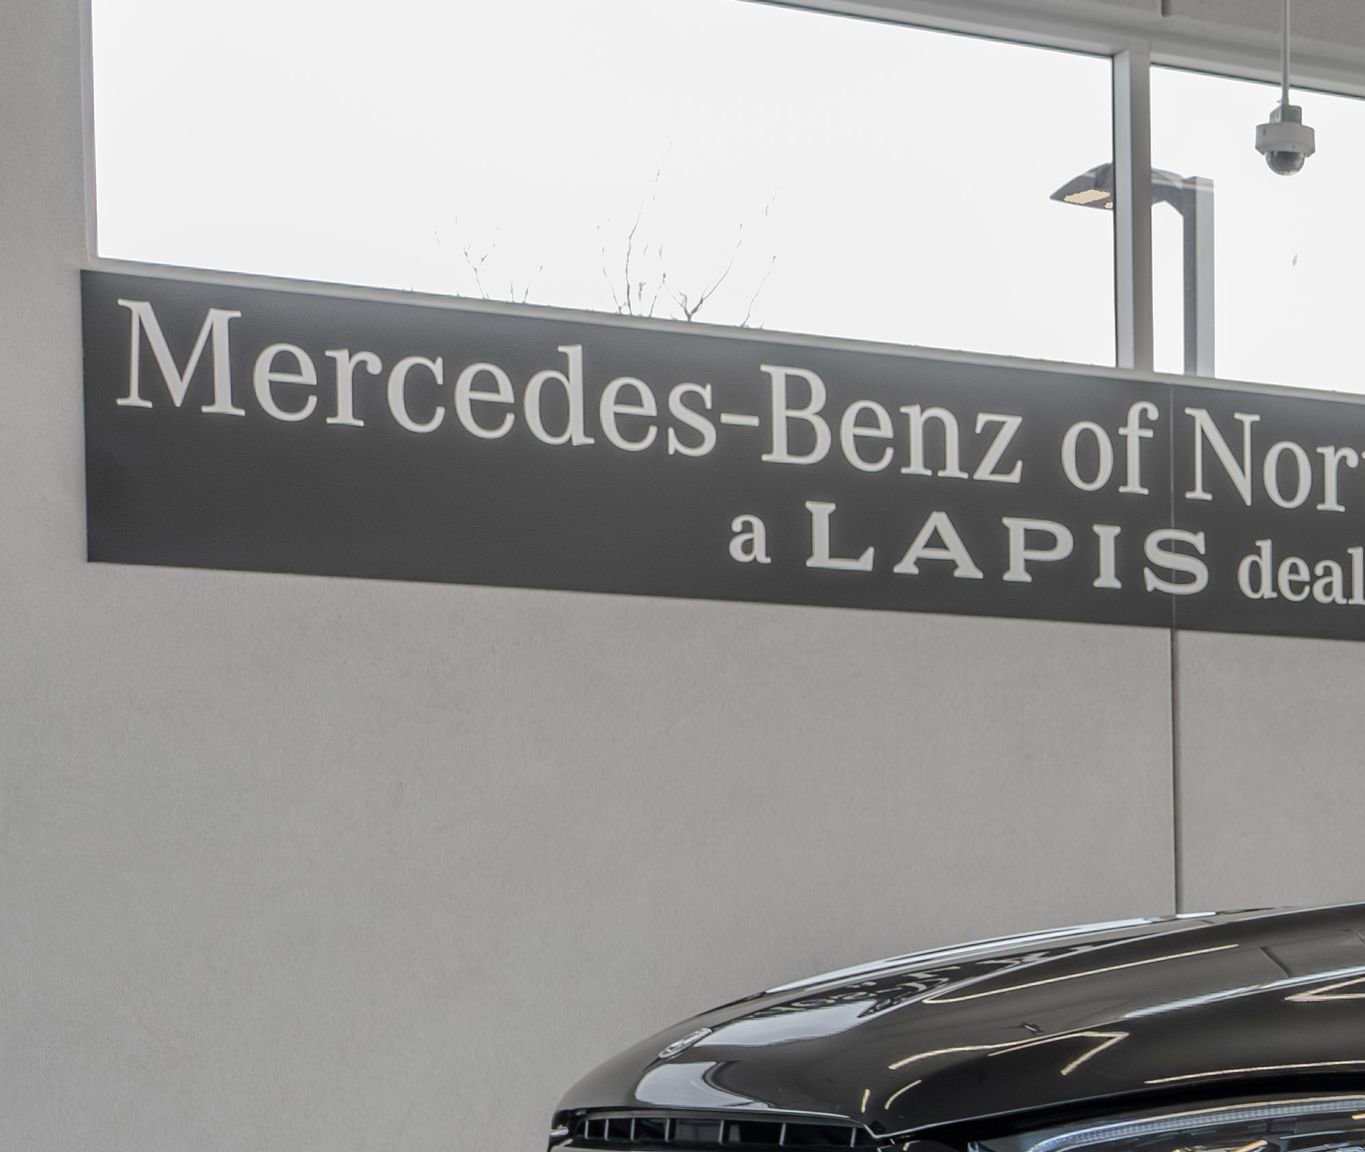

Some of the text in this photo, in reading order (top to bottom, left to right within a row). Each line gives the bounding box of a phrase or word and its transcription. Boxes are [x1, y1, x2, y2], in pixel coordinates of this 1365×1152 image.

[116, 298, 1024, 484] Mercedes-Benz
[1061, 400, 1160, 495] of
[728, 514, 772, 564] a
[804, 500, 1210, 595] LAPIS
